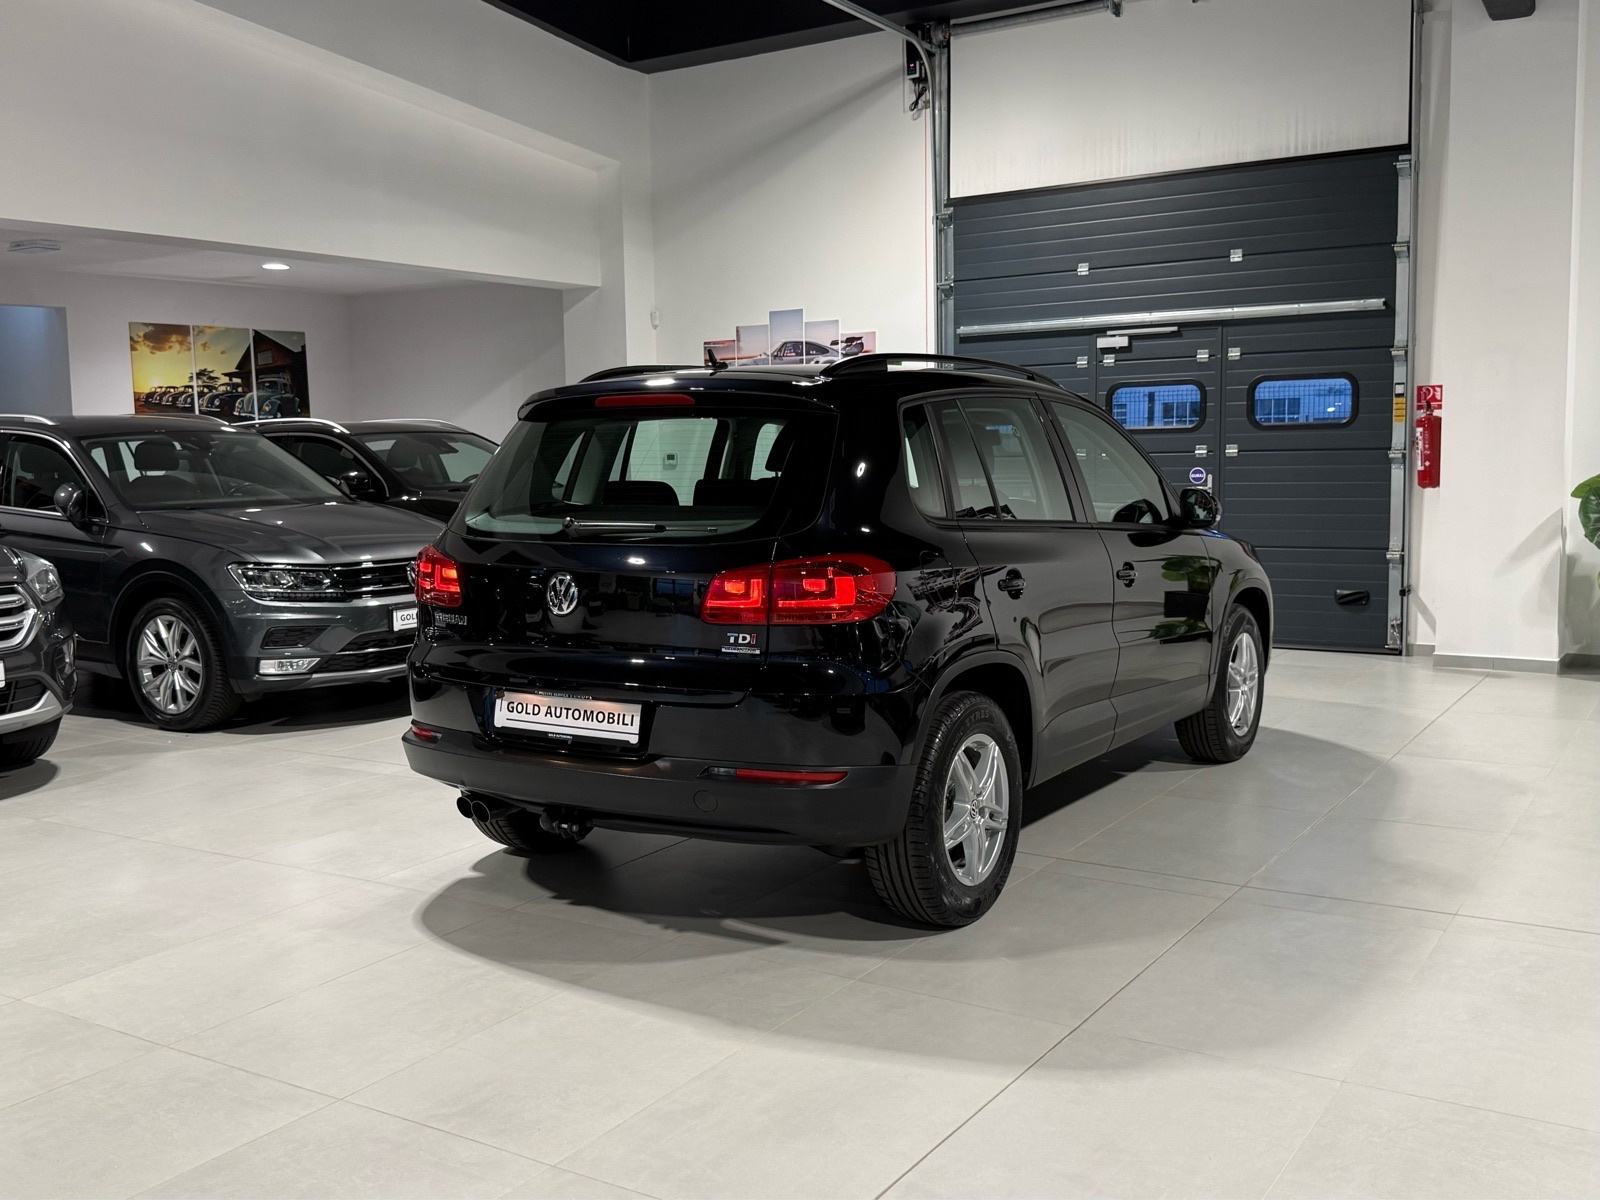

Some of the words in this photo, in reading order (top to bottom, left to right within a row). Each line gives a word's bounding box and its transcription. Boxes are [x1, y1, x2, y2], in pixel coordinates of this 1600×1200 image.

[400, 613, 416, 622] GOL
[506, 701, 541, 716] GOLD
[544, 705, 635, 727] AUTOMOBILI
